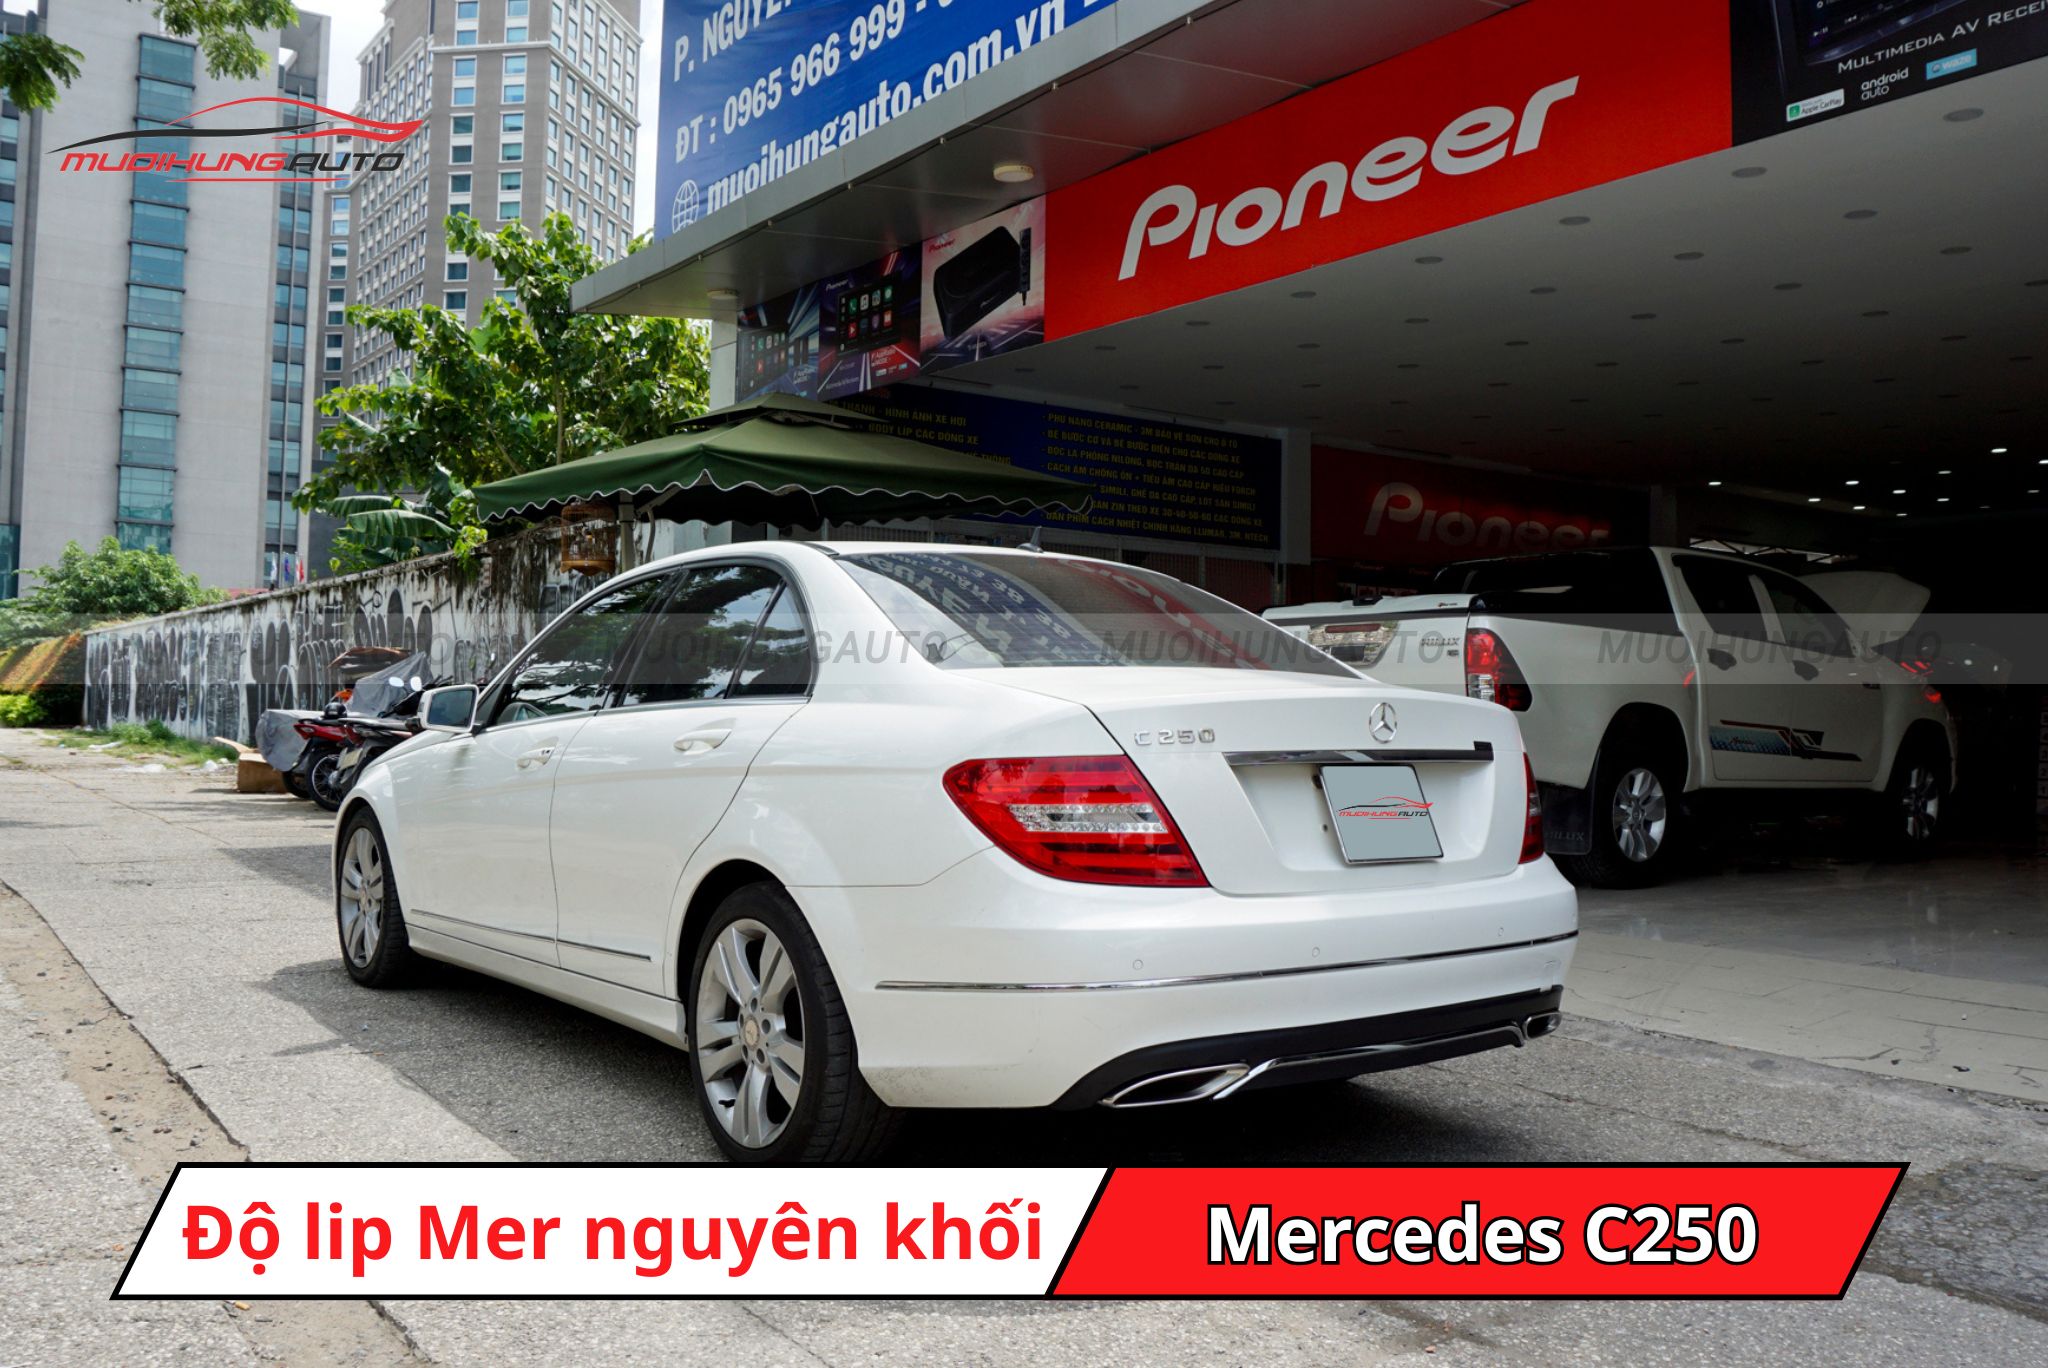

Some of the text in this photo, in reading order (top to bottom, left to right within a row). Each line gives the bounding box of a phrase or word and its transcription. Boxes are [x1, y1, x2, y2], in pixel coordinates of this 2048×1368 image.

[674, 35, 694, 82] P.
[1838, 0, 2048, 74] MULTIMEDIA AV RECEI
[676, 115, 703, 164] ĐT
[723, 66, 782, 130] 0965
[790, 32, 840, 96] 966
[850, 0, 905, 62] 999
[706, 1, 1065, 215] muoihungauto.com.vn
[1861, 67, 1909, 91] android
[1861, 85, 1890, 101] auto
[1118, 75, 1580, 282] Pioneer
[1363, 481, 1610, 551] Pioneer
[1135, 726, 1215, 746] C 250
